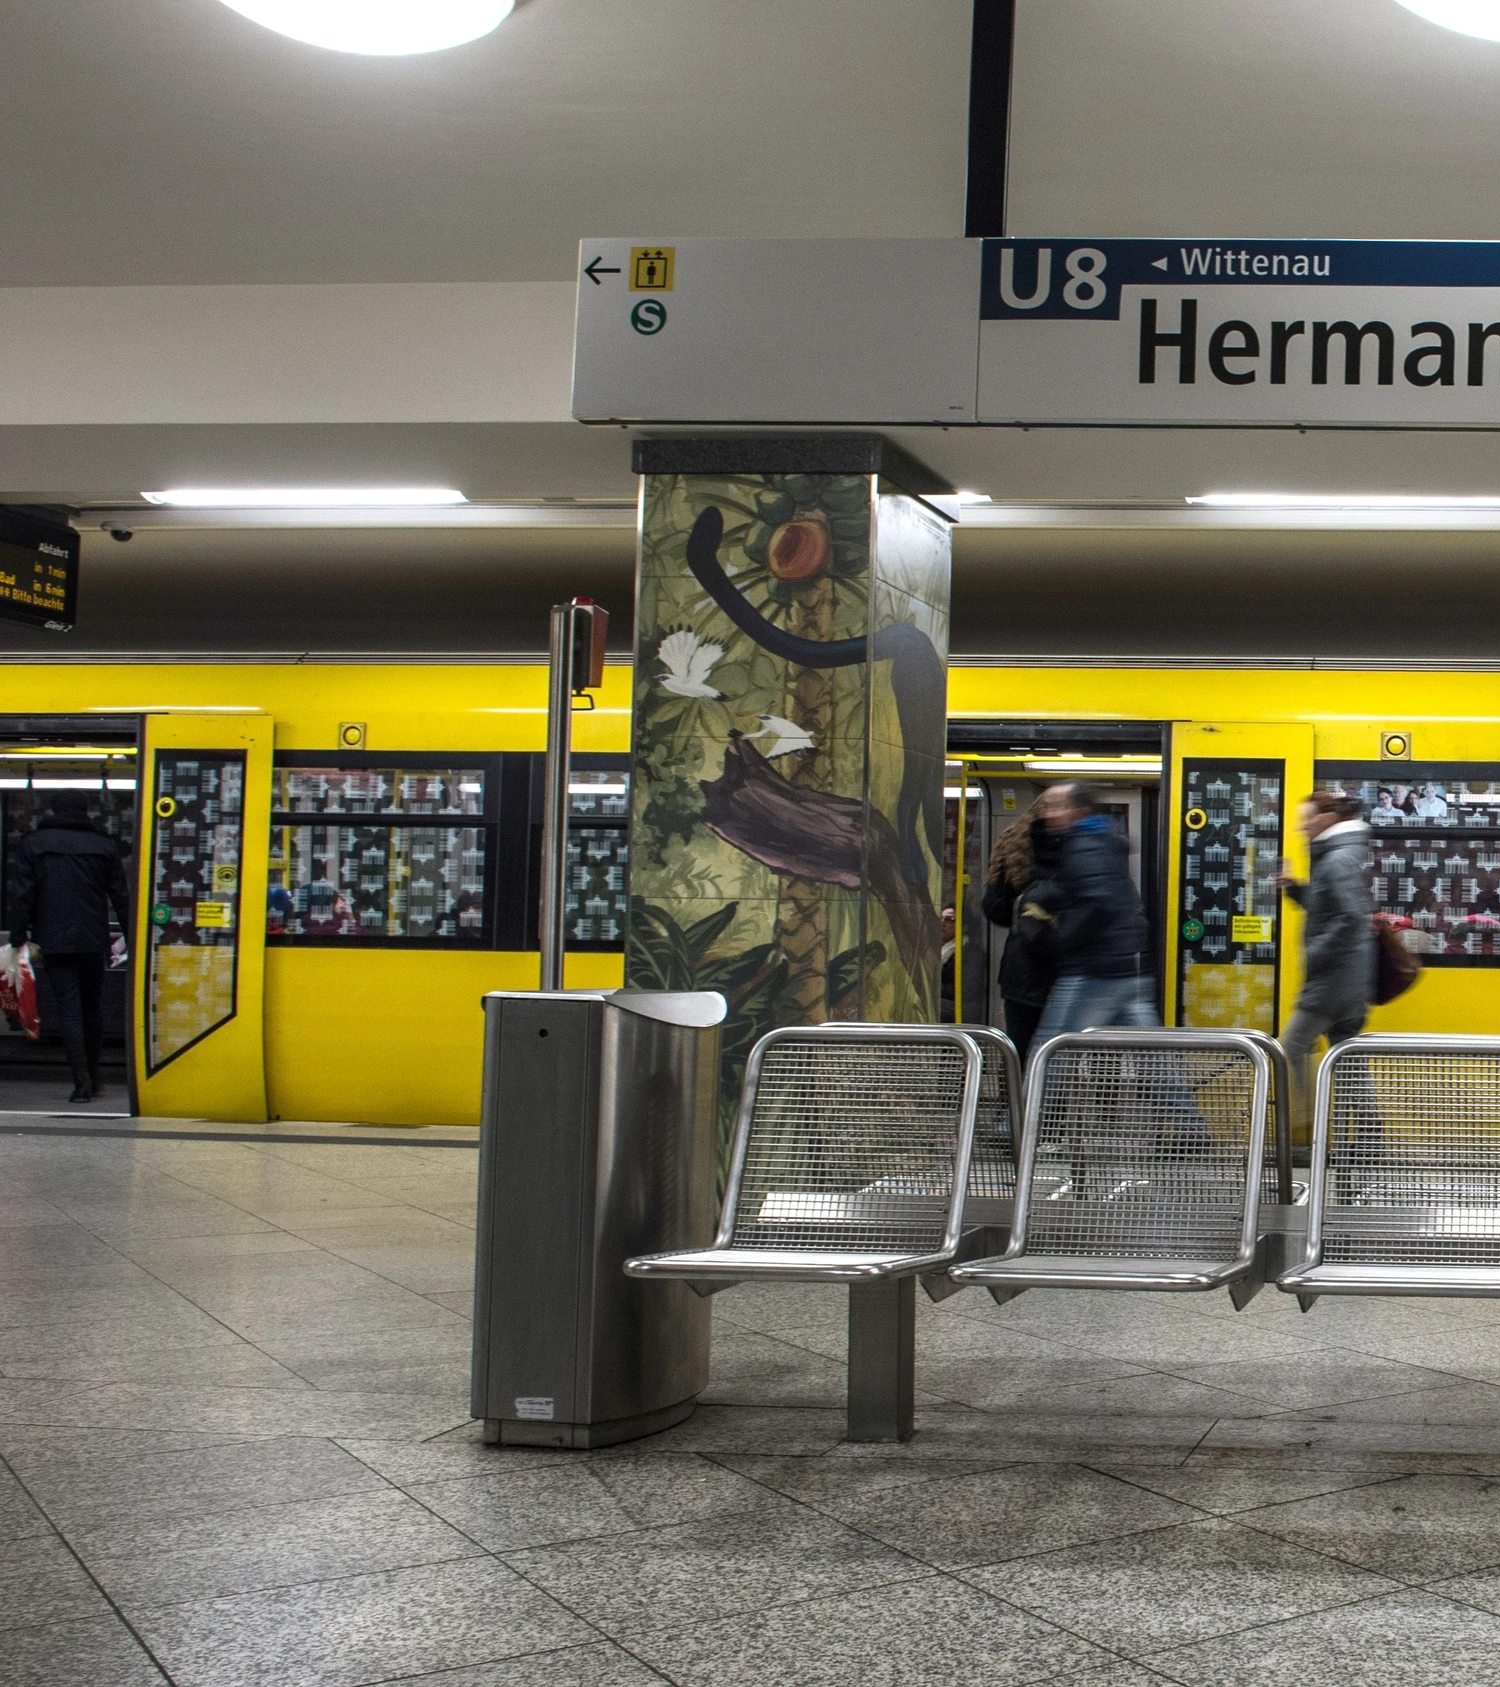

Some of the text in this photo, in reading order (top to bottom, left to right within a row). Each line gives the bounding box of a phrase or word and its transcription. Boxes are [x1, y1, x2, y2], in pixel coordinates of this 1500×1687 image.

[1180, 247, 1331, 277] Wittenau
[1000, 247, 1107, 310] U8
[636, 302, 662, 332] S
[38, 542, 69, 559] Abfahrt
[12, 588, 32, 603] Bitte
